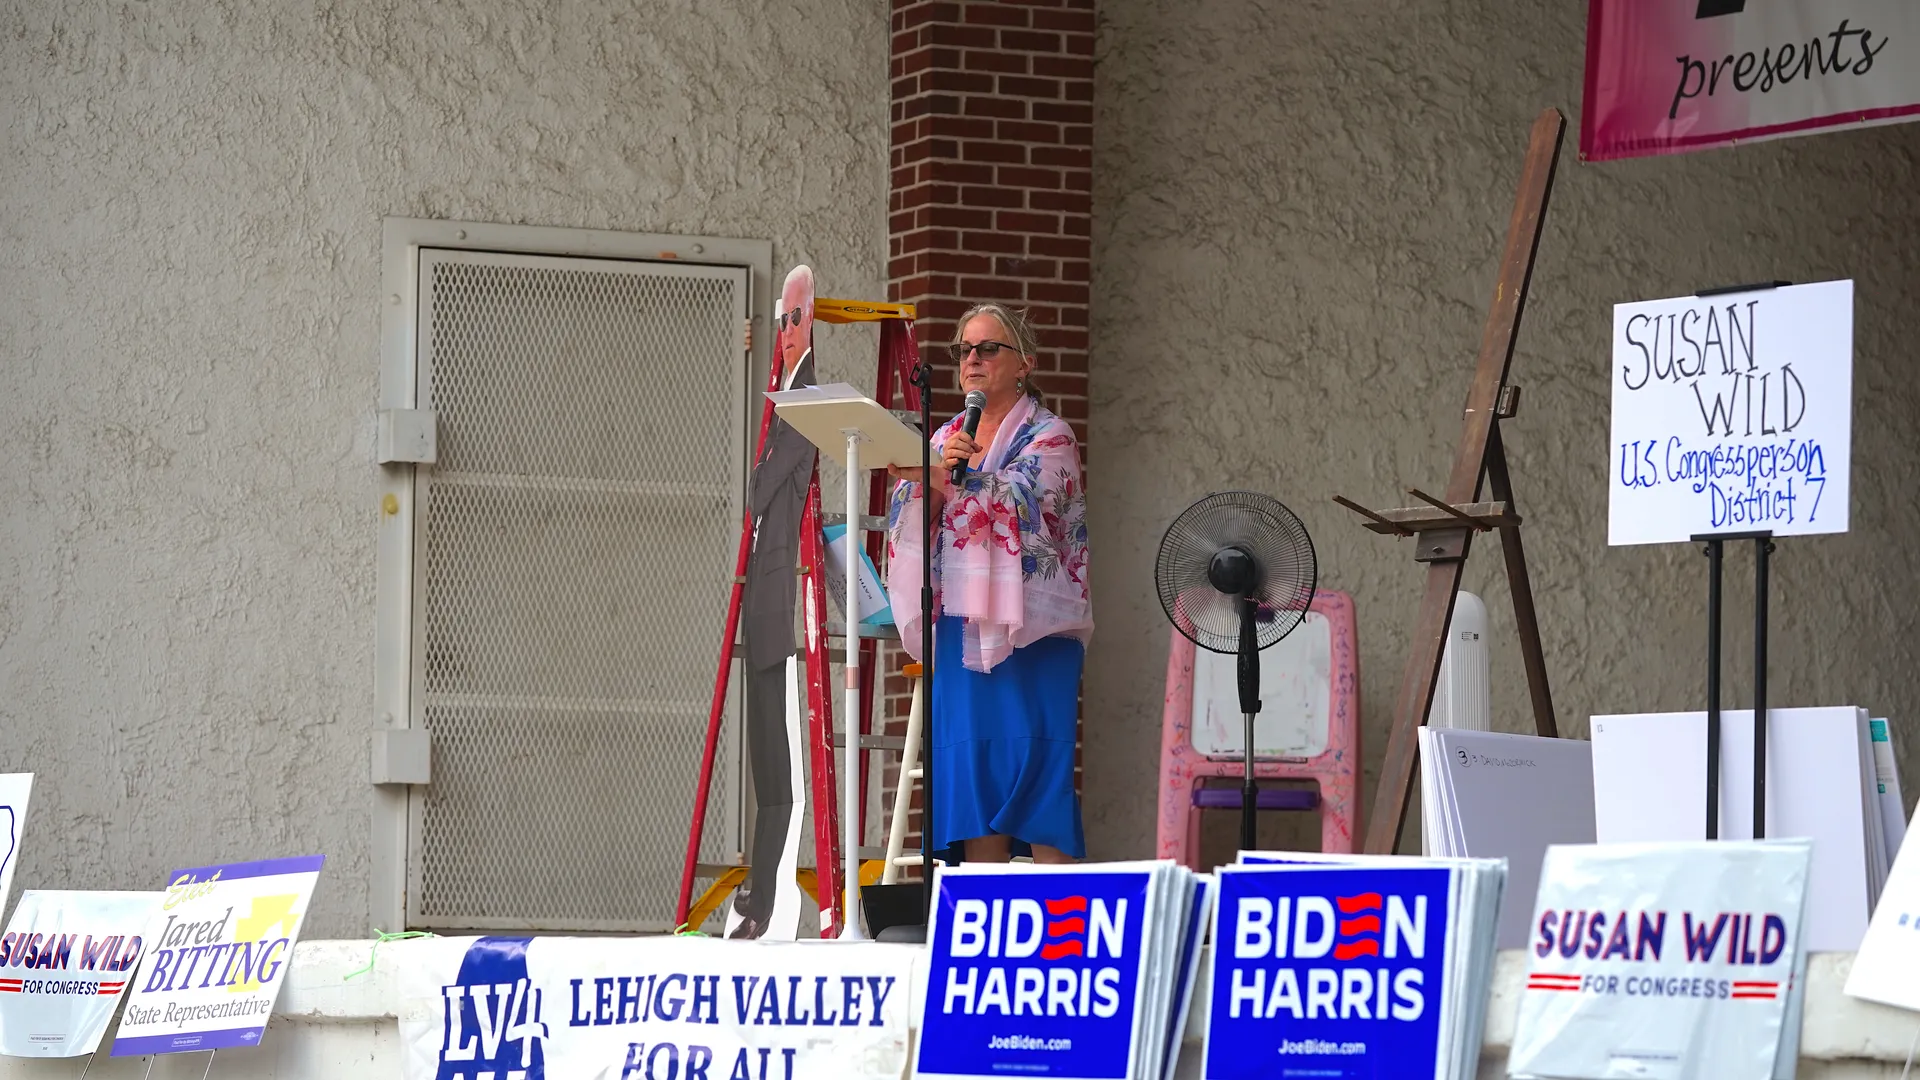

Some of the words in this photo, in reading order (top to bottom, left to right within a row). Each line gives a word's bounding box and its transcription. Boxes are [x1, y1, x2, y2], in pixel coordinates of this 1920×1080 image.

[1669, 19, 1888, 119] presents
[1623, 300, 1758, 390] SUSAN
[1690, 362, 1805, 437] WILD
[1621, 440, 1660, 489] U.S.
[1666, 436, 1826, 493] Congressperson
[1710, 477, 1796, 527] District
[1805, 477, 1825, 522] 7
[163, 869, 222, 911] Elect
[0, 931, 78, 970] SUSAN
[80, 935, 142, 972] WILD
[153, 906, 233, 954] Jared
[950, 895, 1128, 960] BIDEN
[1234, 892, 1427, 960] BIDEN
[1535, 908, 1667, 962] SUSAN
[1682, 912, 1787, 966] WILD
[22, 979, 43, 995] FOR
[45, 980, 99, 996] CONGRESS
[141, 938, 290, 994] BITTING
[1582, 974, 1620, 996] FOR
[1625, 976, 1730, 999] CONGRESS
[124, 1003, 163, 1027] State
[163, 997, 270, 1030] Representative
[569, 973, 720, 1027] LEHIGH
[732, 976, 895, 1027] VALLEY
[943, 967, 1120, 1018] HARRIS
[1229, 968, 1425, 1021] HARRIS
[621, 1042, 713, 1080] FOR
[988, 1035, 1072, 1050] JoeBiden.com
[1278, 1039, 1366, 1056] JoeBiden.com
